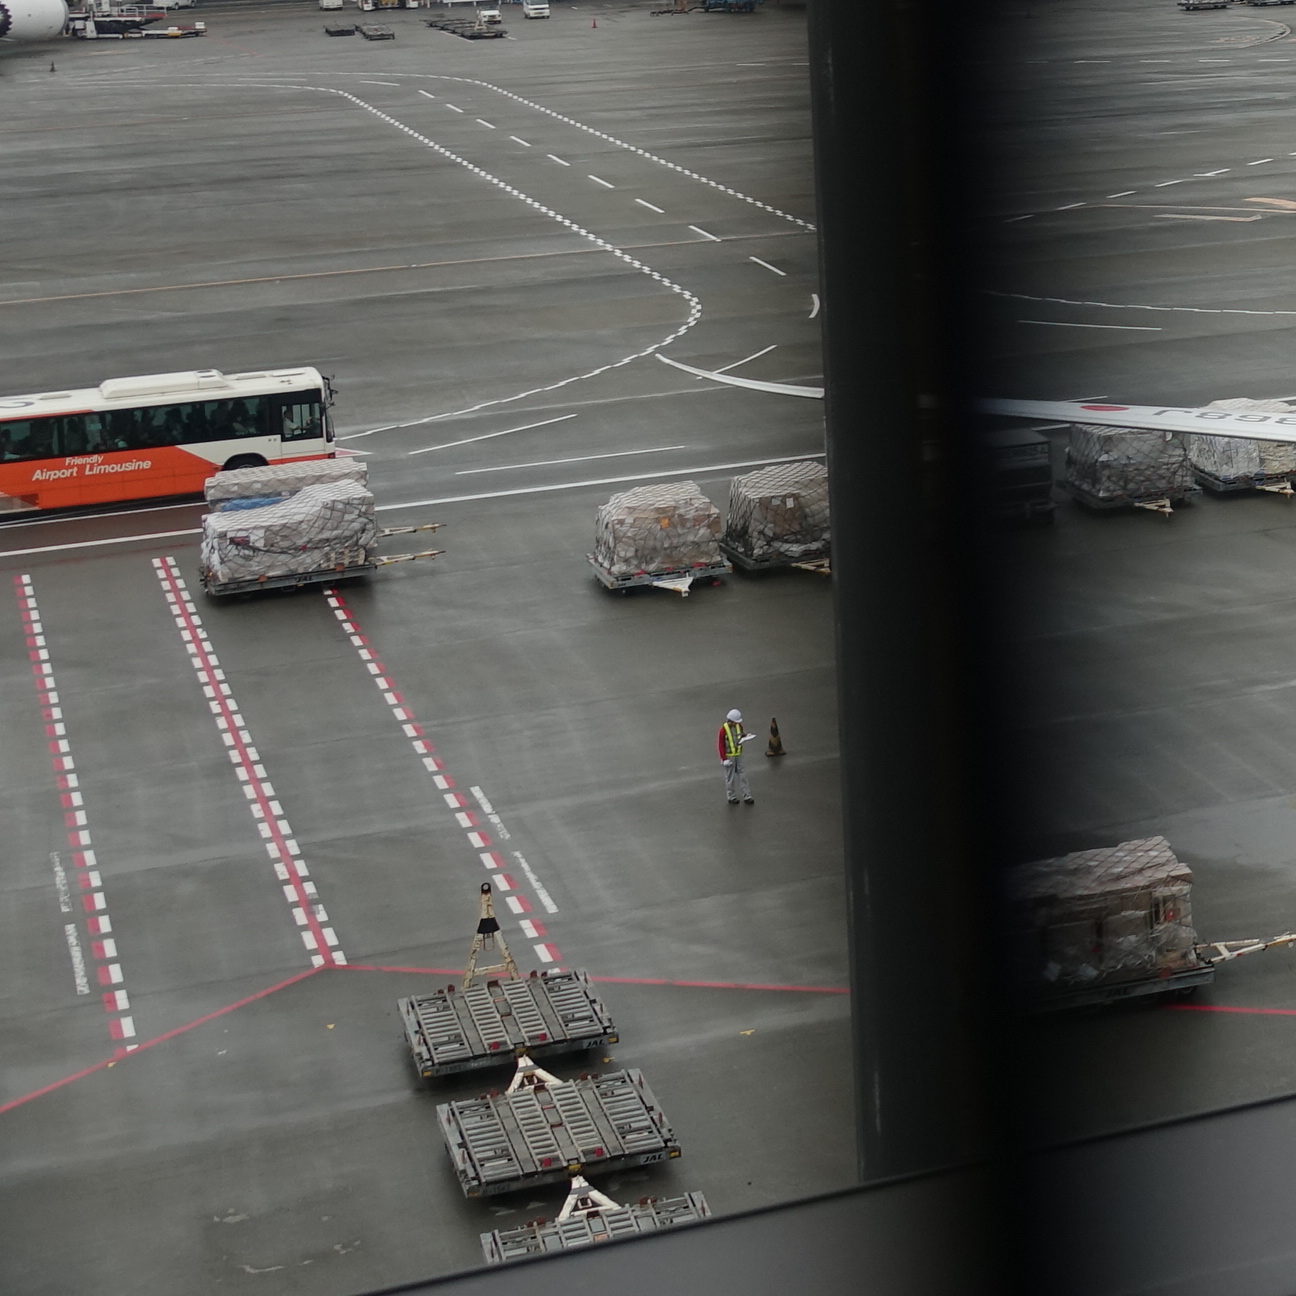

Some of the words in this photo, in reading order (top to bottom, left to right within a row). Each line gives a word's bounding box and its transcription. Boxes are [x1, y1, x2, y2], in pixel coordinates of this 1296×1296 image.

[65, 454, 104, 466] Friendly
[32, 467, 78, 482] Airport
[85, 459, 151, 476] Limousine
[585, 1039, 605, 1049] JAL
[642, 1153, 664, 1164] JAL
